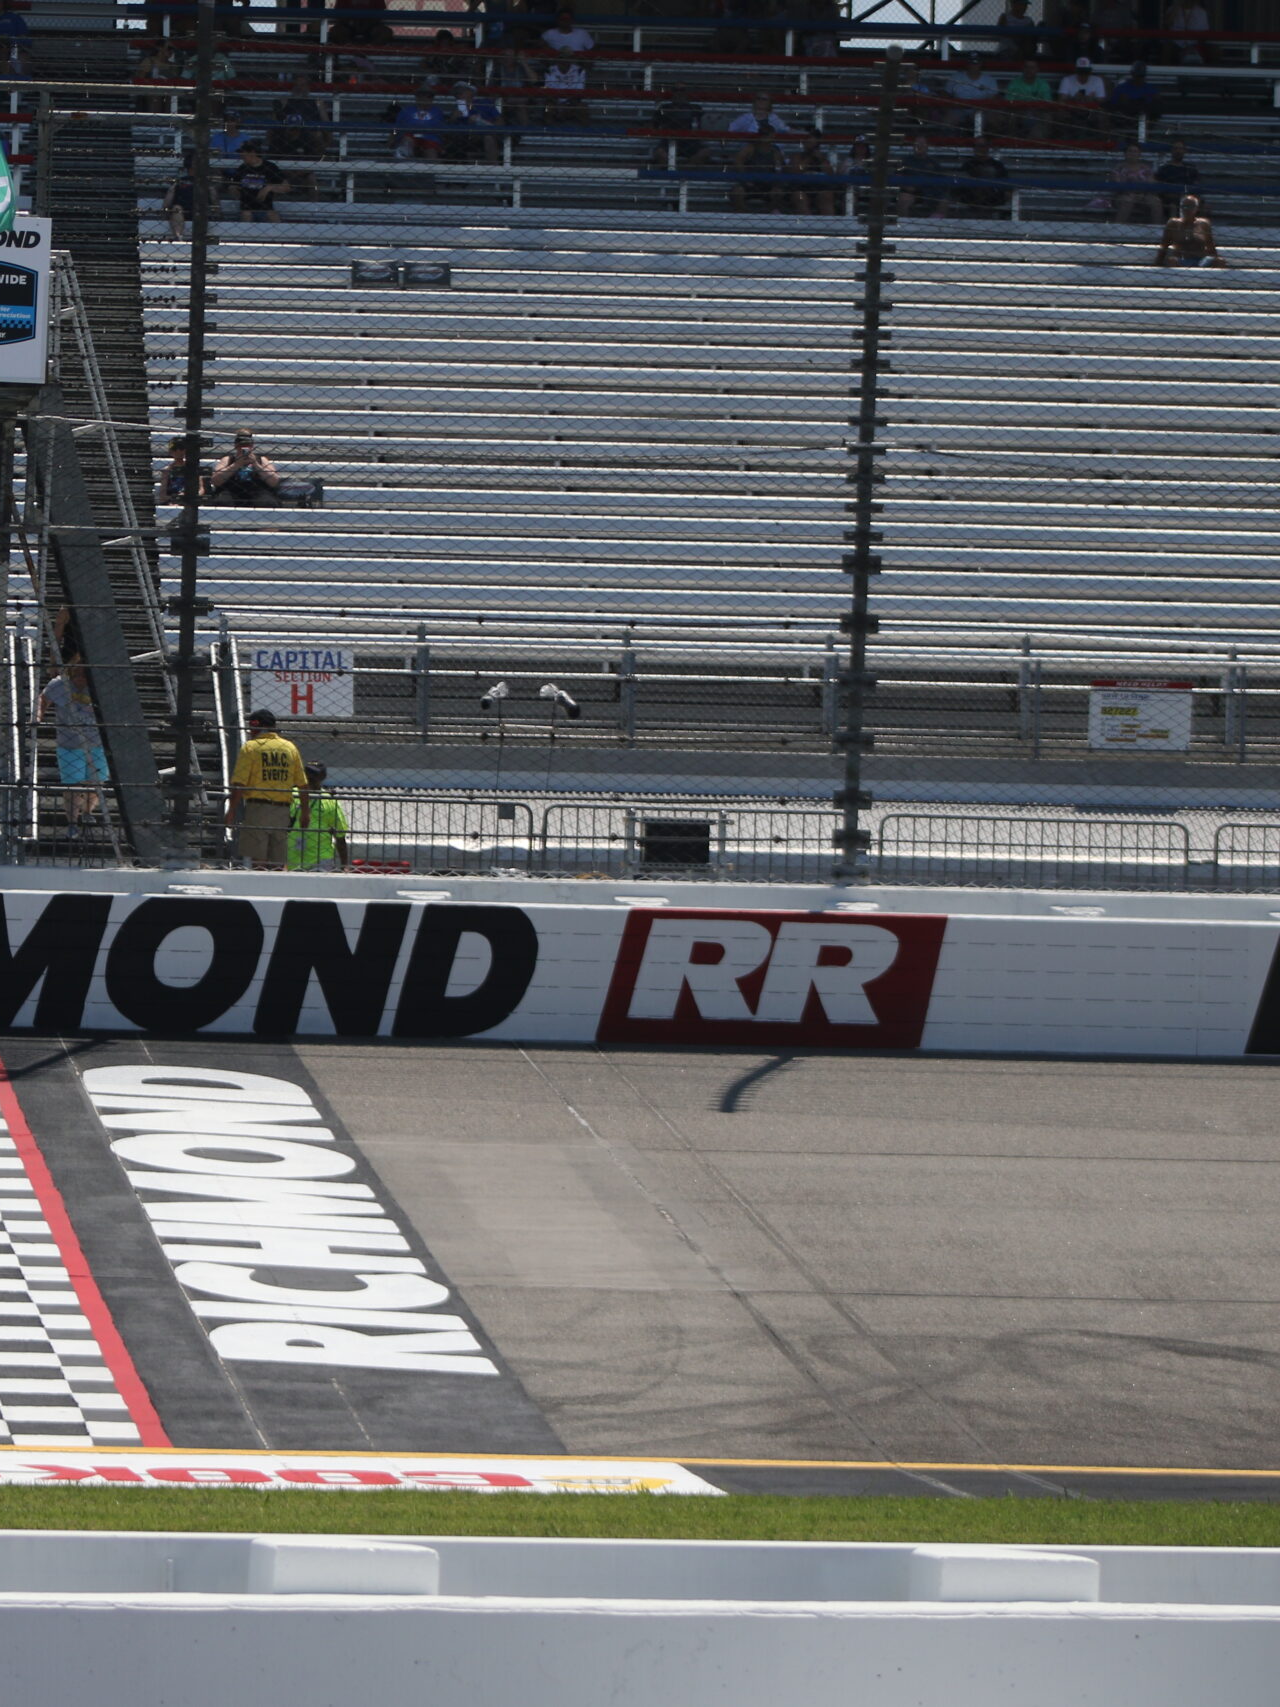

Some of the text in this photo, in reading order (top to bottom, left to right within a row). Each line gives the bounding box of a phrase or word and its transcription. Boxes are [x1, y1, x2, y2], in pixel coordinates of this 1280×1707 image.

[256, 650, 348, 670] CAPITAL
[274, 670, 333, 683] SECTION
[290, 684, 314, 714] H
[626, 917, 901, 1025] RR
[81, 1064, 501, 1376] RICHMOND
